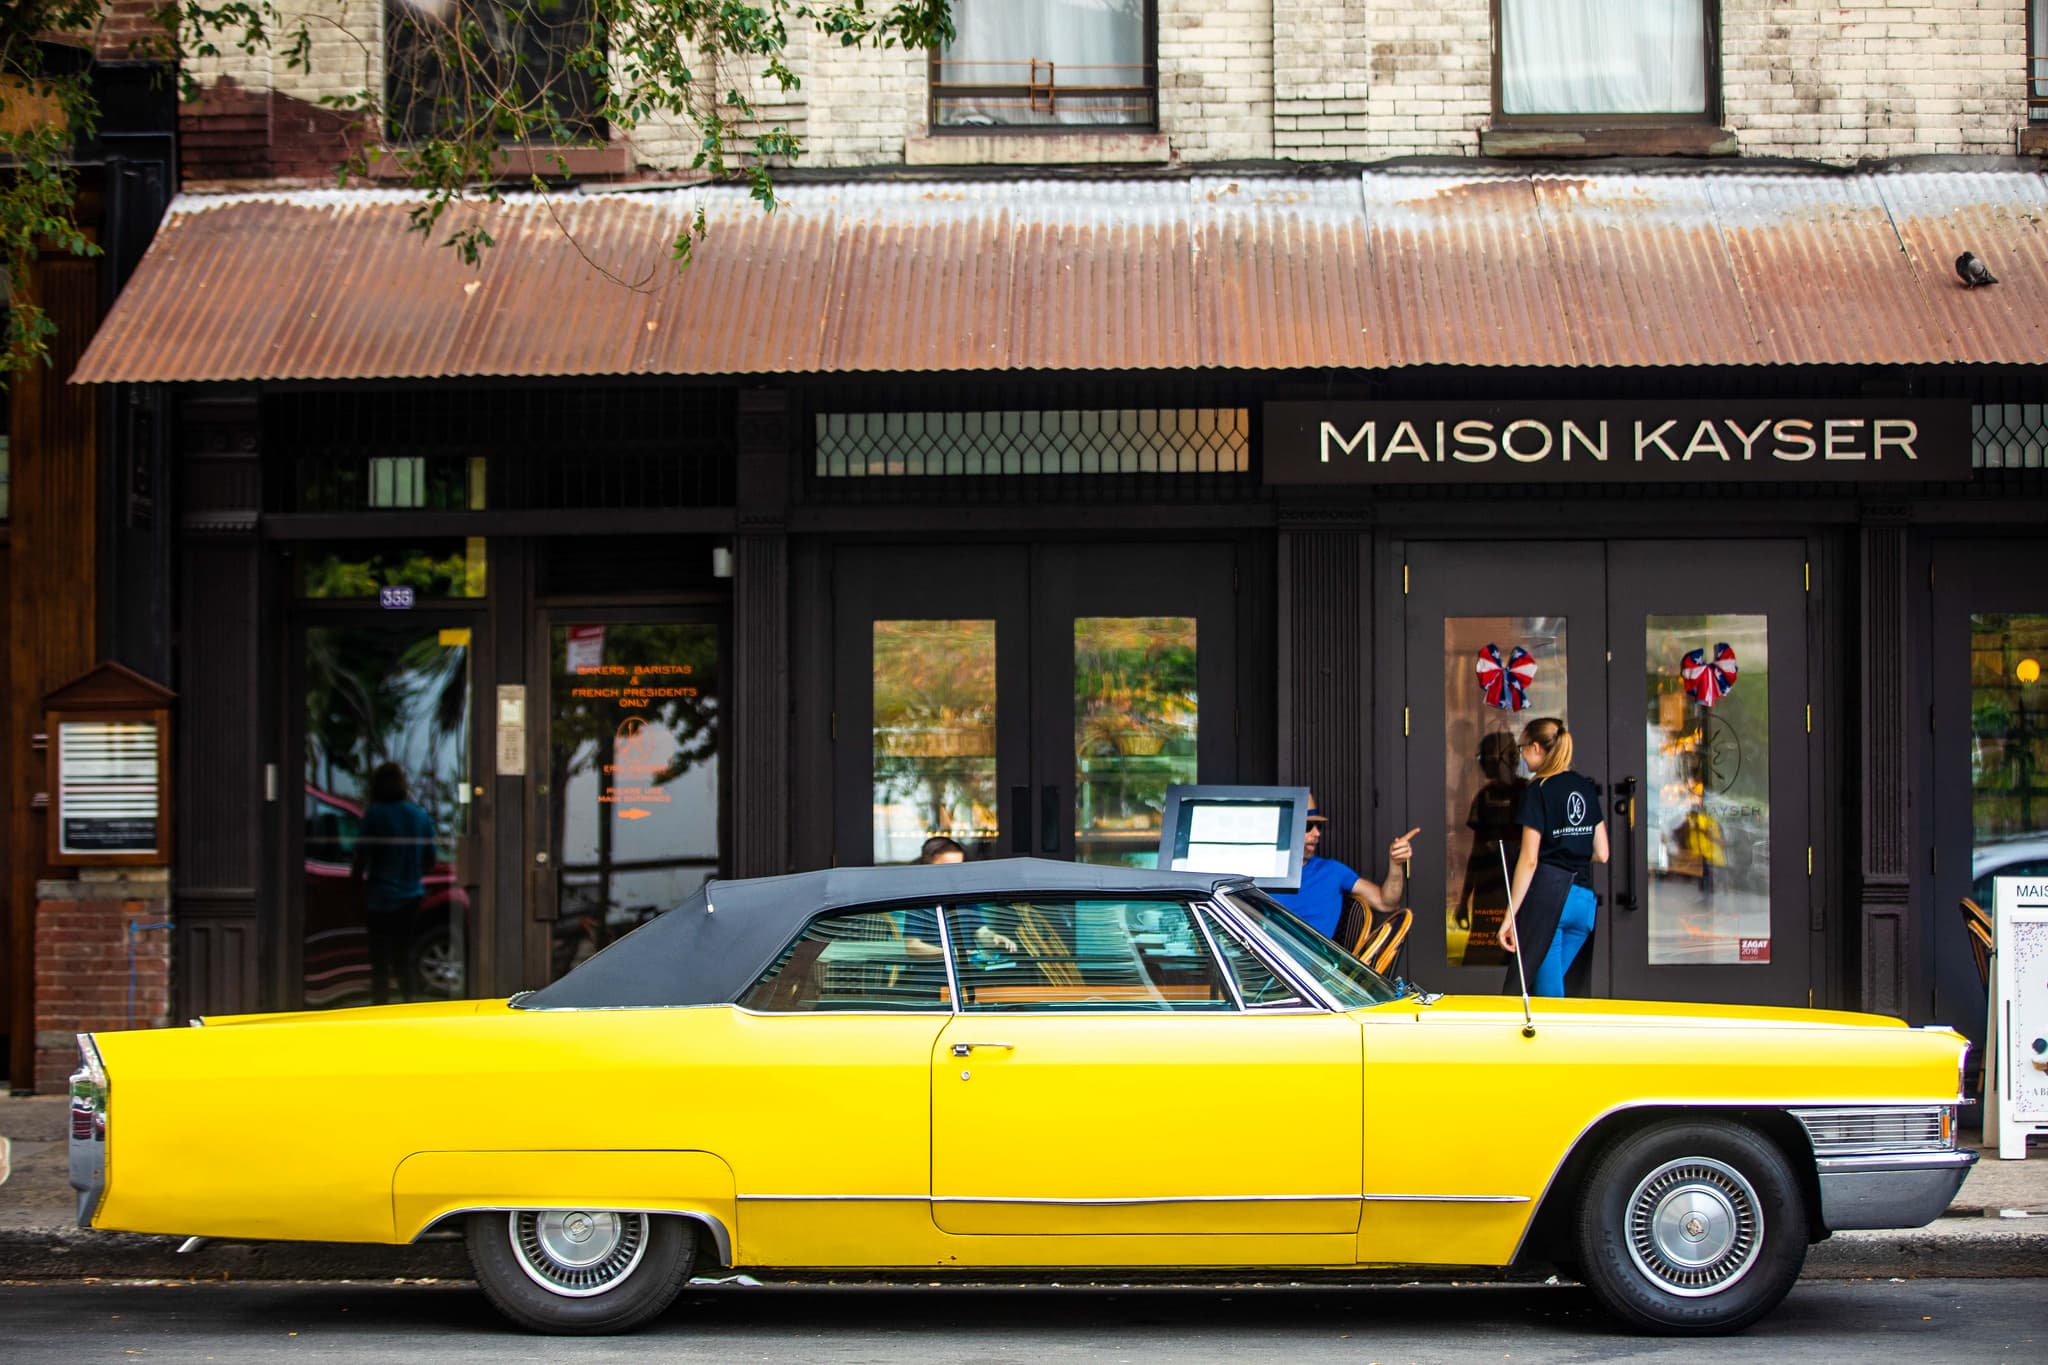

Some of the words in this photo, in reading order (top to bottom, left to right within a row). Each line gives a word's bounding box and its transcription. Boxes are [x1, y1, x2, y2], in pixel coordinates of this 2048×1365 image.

[1319, 418, 1608, 463] MAISON
[1634, 418, 1919, 462] KAYSER
[633, 664, 692, 675] BARISTAS
[629, 675, 640, 686] &
[571, 687, 619, 698] FRENCH
[623, 687, 698, 697] PRESIDENTS
[618, 698, 650, 708] ONLY
[1699, 806, 1761, 817] AYSER
[1742, 939, 1768, 948] ZAGAT
